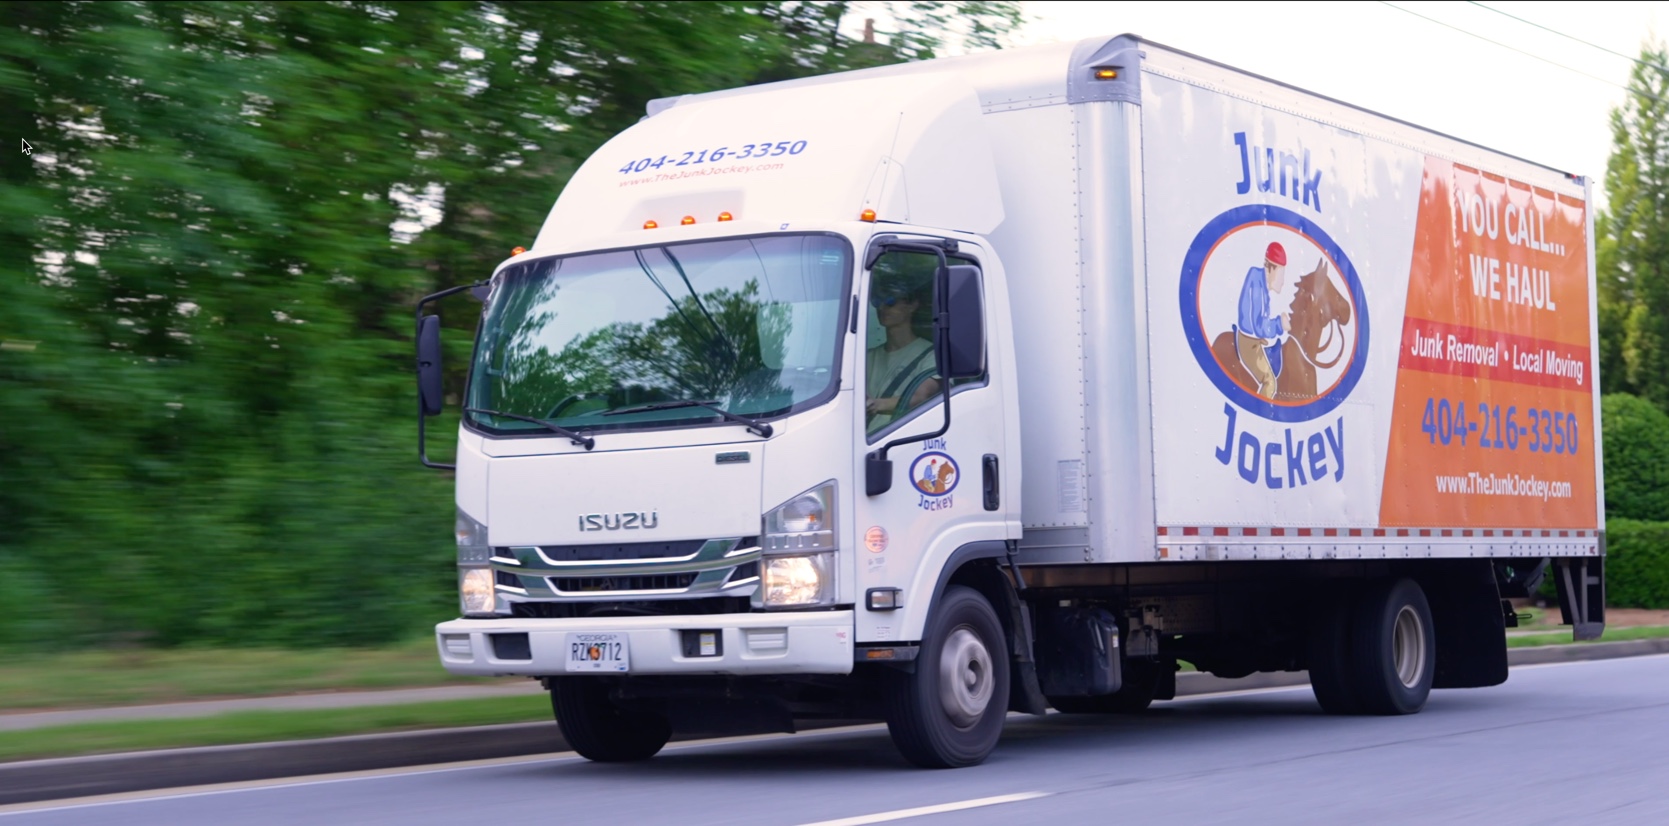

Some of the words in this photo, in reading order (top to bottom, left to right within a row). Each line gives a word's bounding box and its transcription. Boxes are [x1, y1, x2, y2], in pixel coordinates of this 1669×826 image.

[618, 140, 808, 175] 404-216-3350
[618, 162, 785, 187] www.TheJunkJockey.com
[1233, 131, 1323, 213] Junk
[1457, 192, 1499, 240] YOU
[1504, 203, 1566, 257] CALL...
[1469, 253, 1501, 300] WE
[1506, 262, 1556, 312] HAUL
[1411, 329, 1444, 360] Junk
[1446, 334, 1499, 367] Removal
[1512, 344, 1544, 374] Local
[1545, 350, 1584, 386] Moving
[1215, 402, 1344, 490] Jockey
[1421, 397, 1579, 456] 404-216-3350
[918, 494, 954, 512] Jockey
[1436, 472, 1572, 502] www.TheJunkJockey.com
[578, 511, 659, 532] ISUZU
